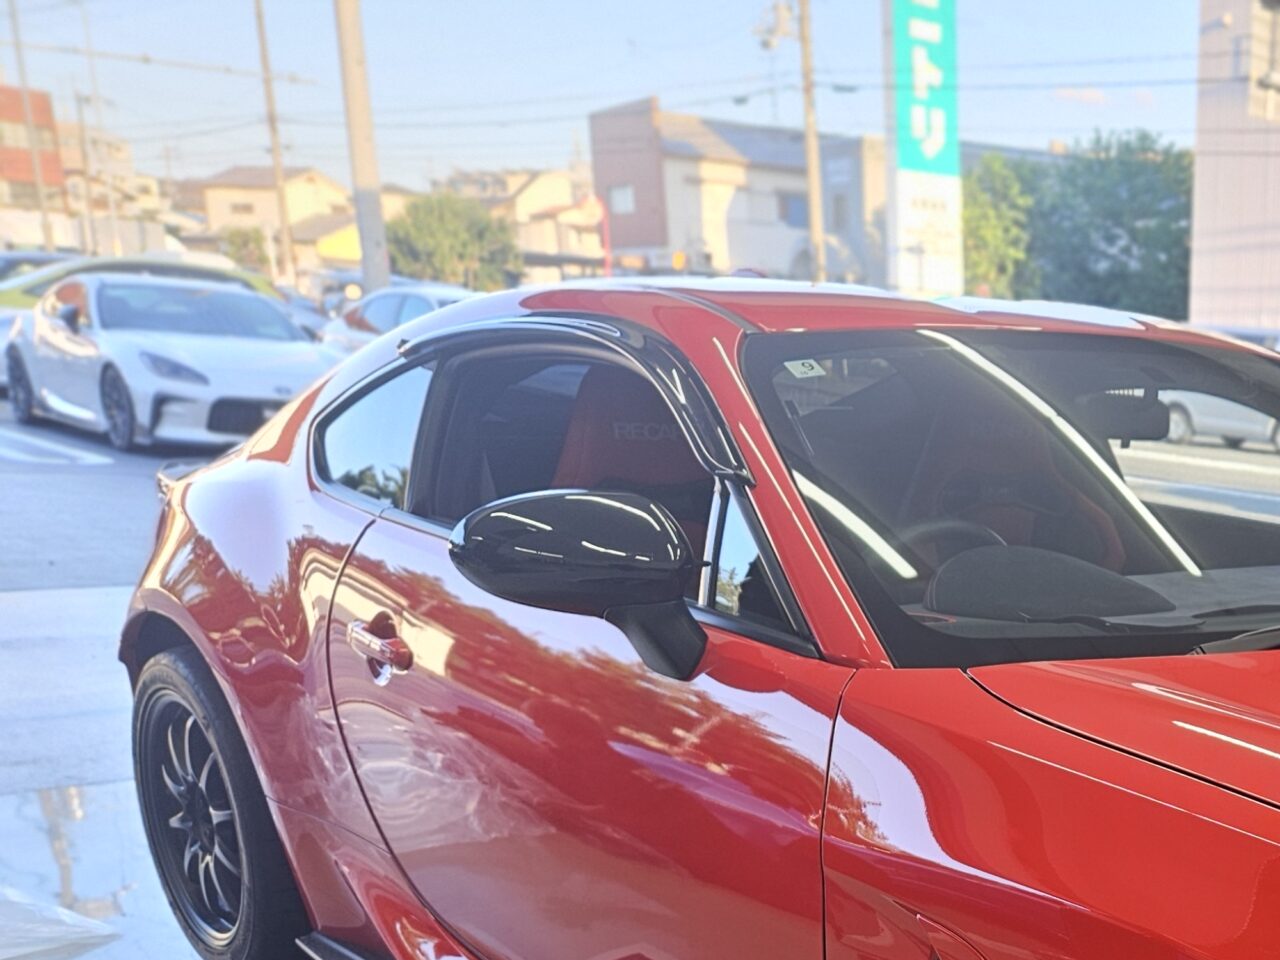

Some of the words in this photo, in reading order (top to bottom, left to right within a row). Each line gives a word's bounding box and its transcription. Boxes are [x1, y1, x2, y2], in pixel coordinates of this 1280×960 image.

[907, 0, 947, 160] ニトリ
[801, 361, 815, 371] 9
